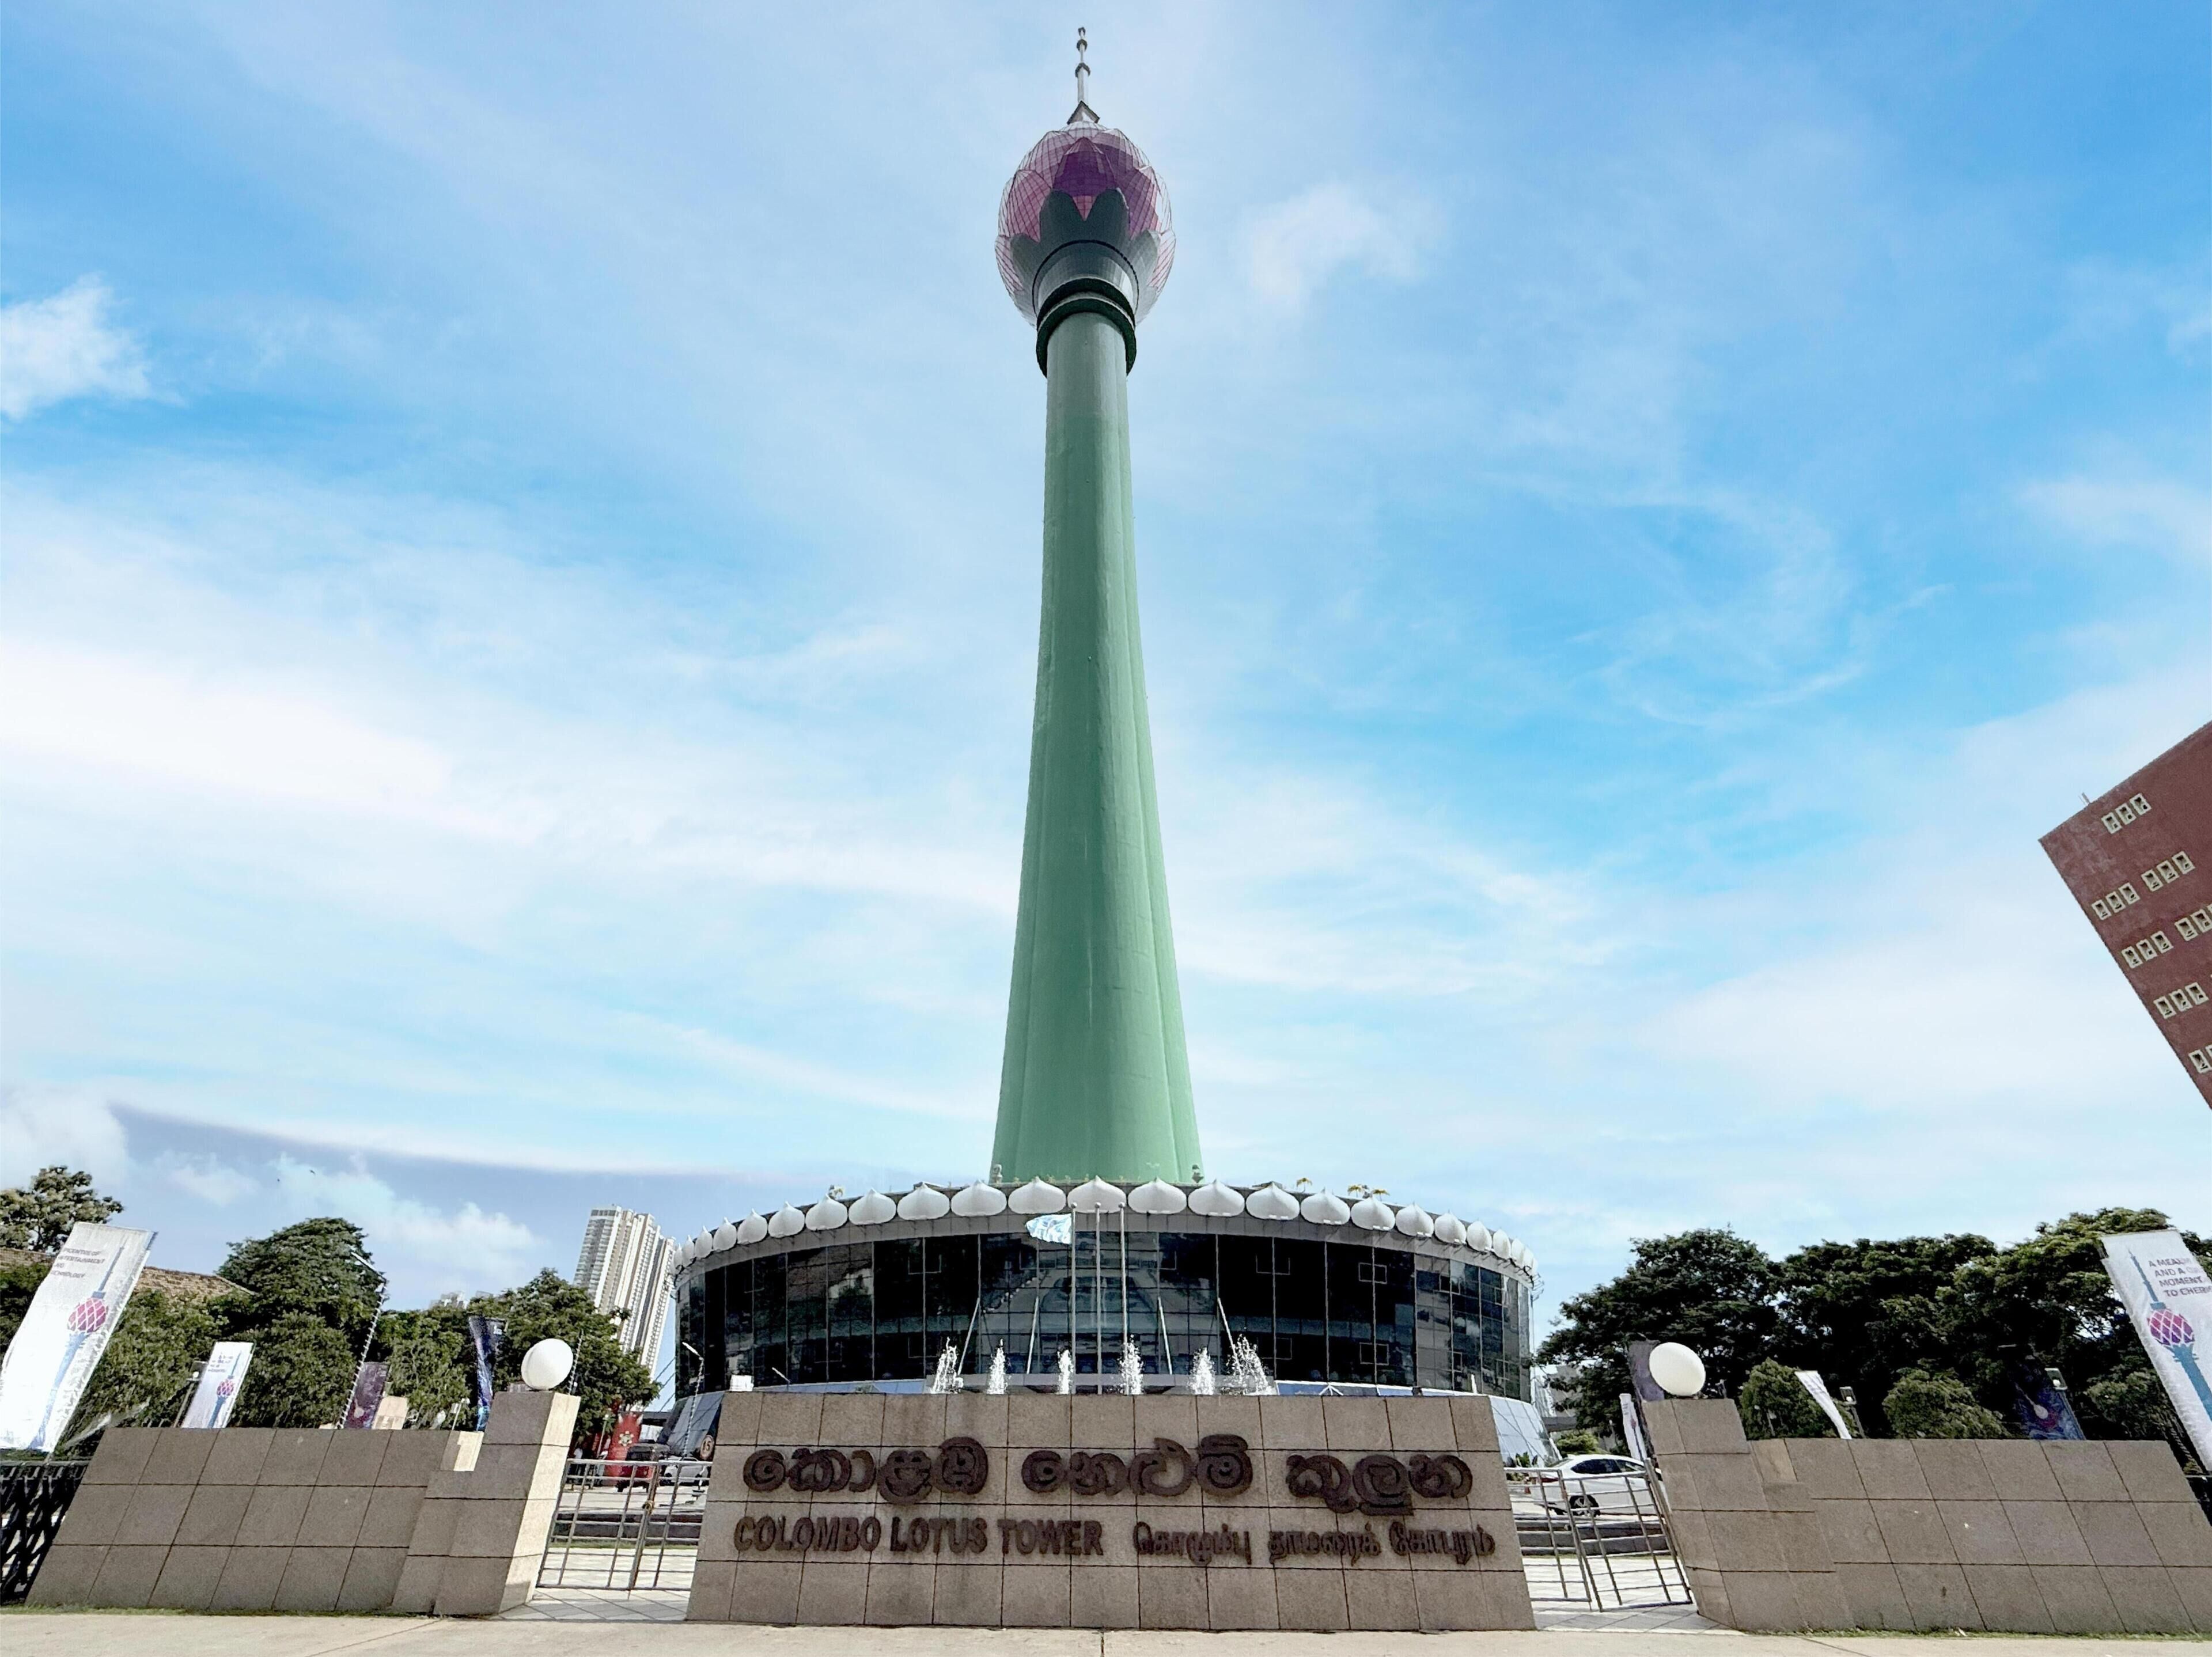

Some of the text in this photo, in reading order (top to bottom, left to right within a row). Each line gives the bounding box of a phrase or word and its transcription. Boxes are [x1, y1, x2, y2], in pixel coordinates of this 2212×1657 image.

[2154, 1268, 2176, 1277] AND
[2158, 1276, 2203, 1287] MOMENT
[703, 1440, 711, 1451] 15
[743, 1436, 989, 1504] කොළඹ
[734, 1516, 1104, 1556] COLOMBO LOTUS TOWER
[1133, 1521, 1496, 1567] கொழும்பு தாமரைக் கோபுரம்
